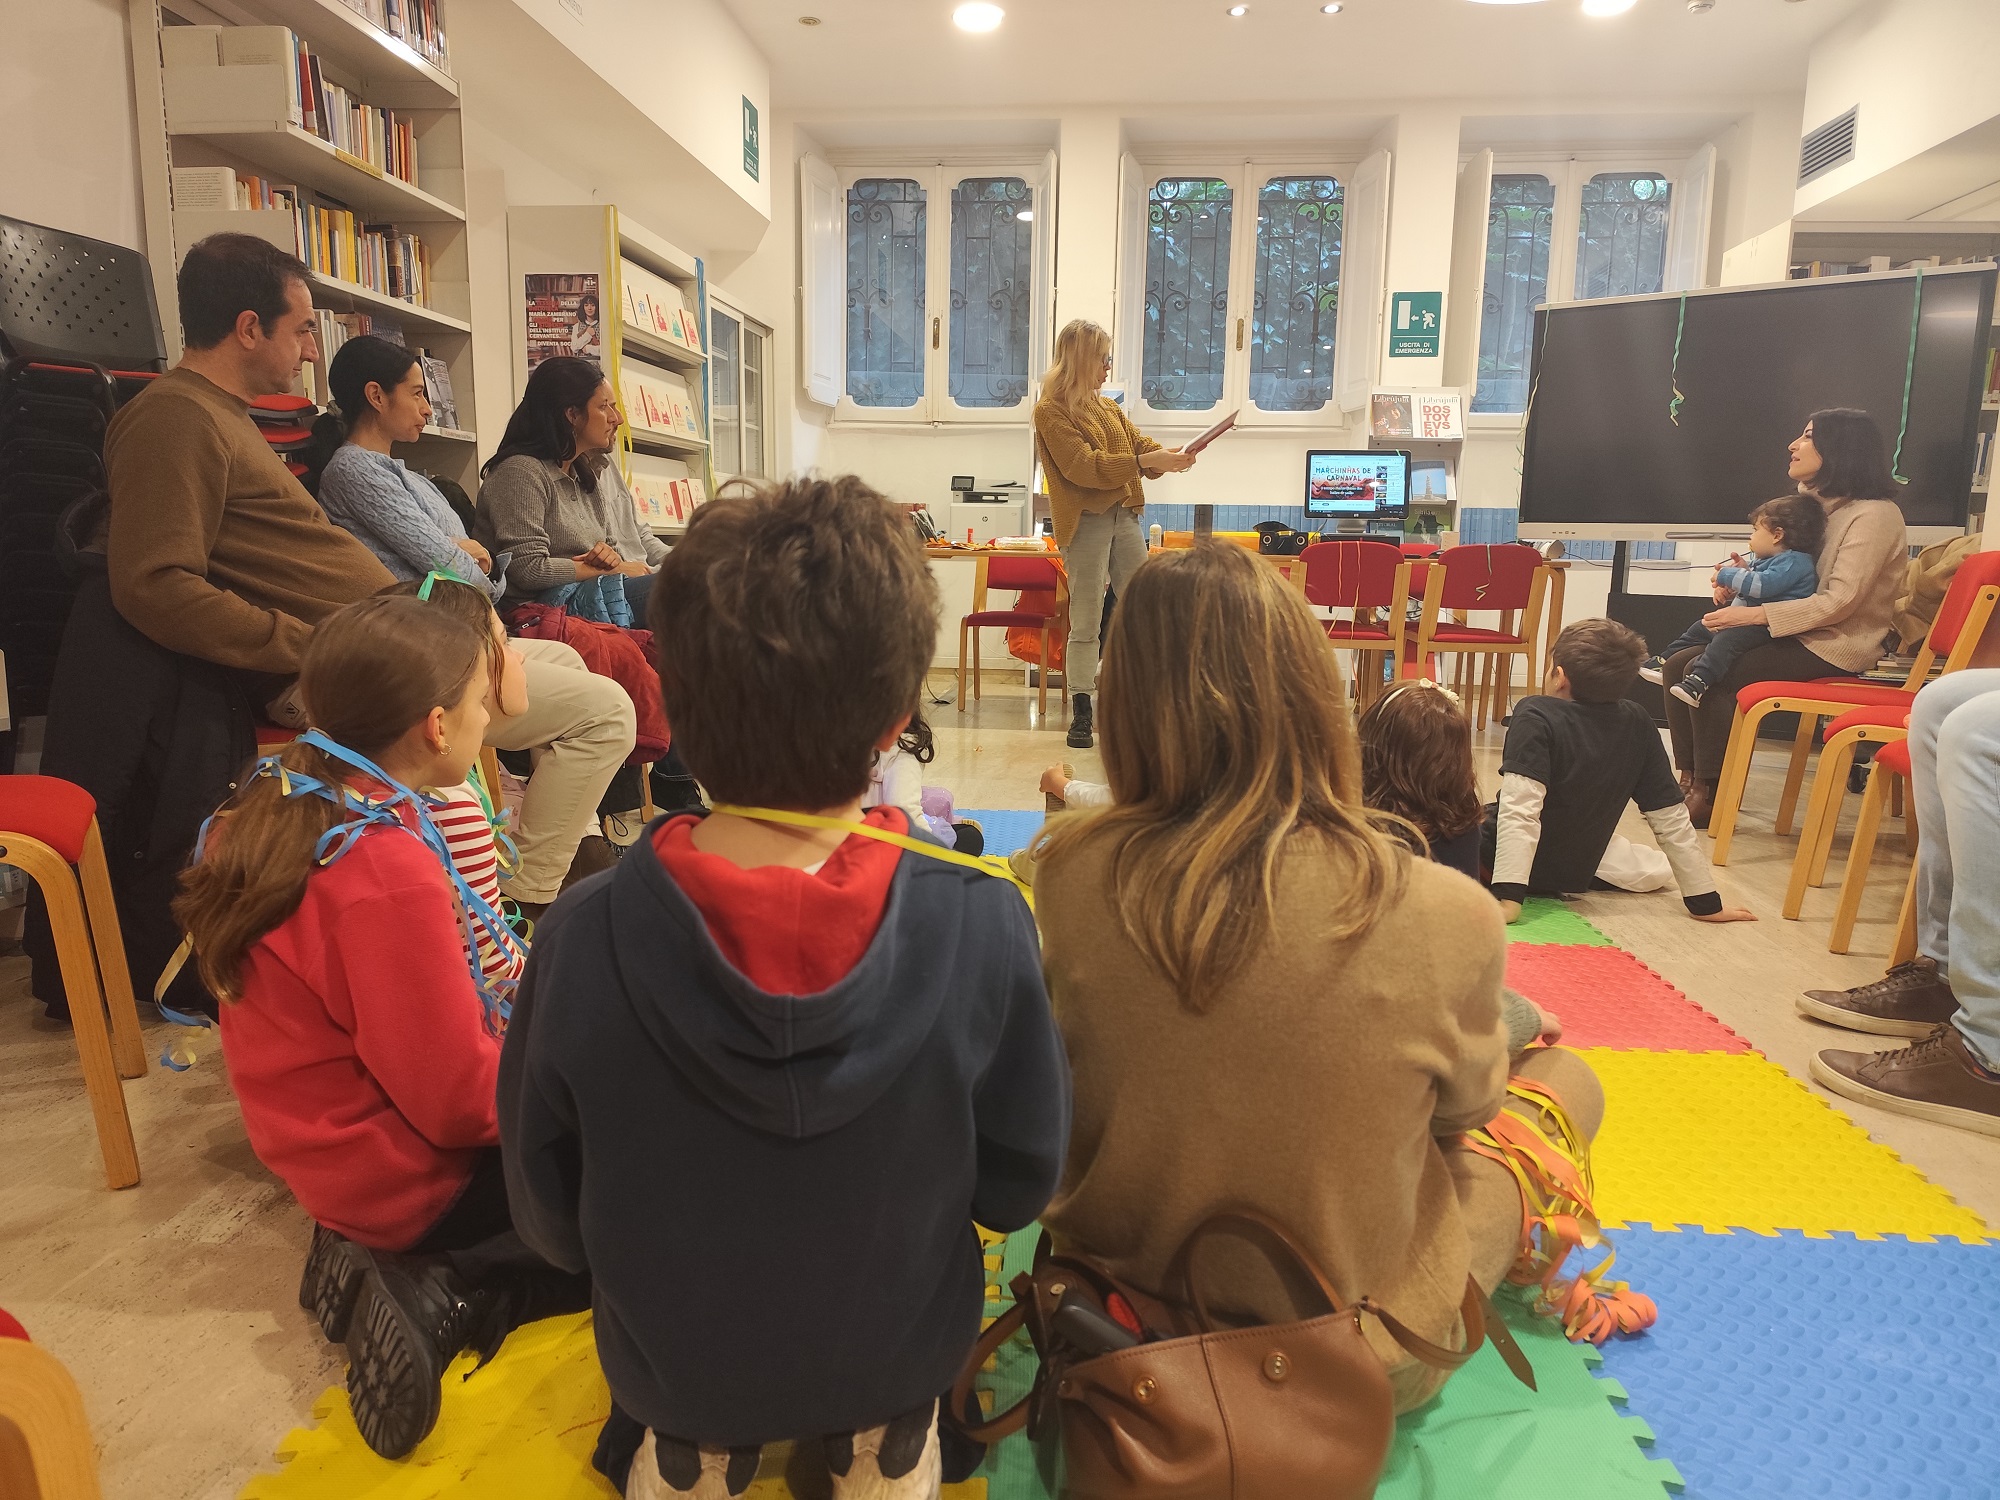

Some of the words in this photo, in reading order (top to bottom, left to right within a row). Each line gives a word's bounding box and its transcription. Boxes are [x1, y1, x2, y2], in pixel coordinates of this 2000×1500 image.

[1422, 405, 1451, 413] DOS
[1423, 413, 1451, 421] TOY
[1423, 421, 1451, 429] EVS
[1424, 429, 1439, 437] KI
